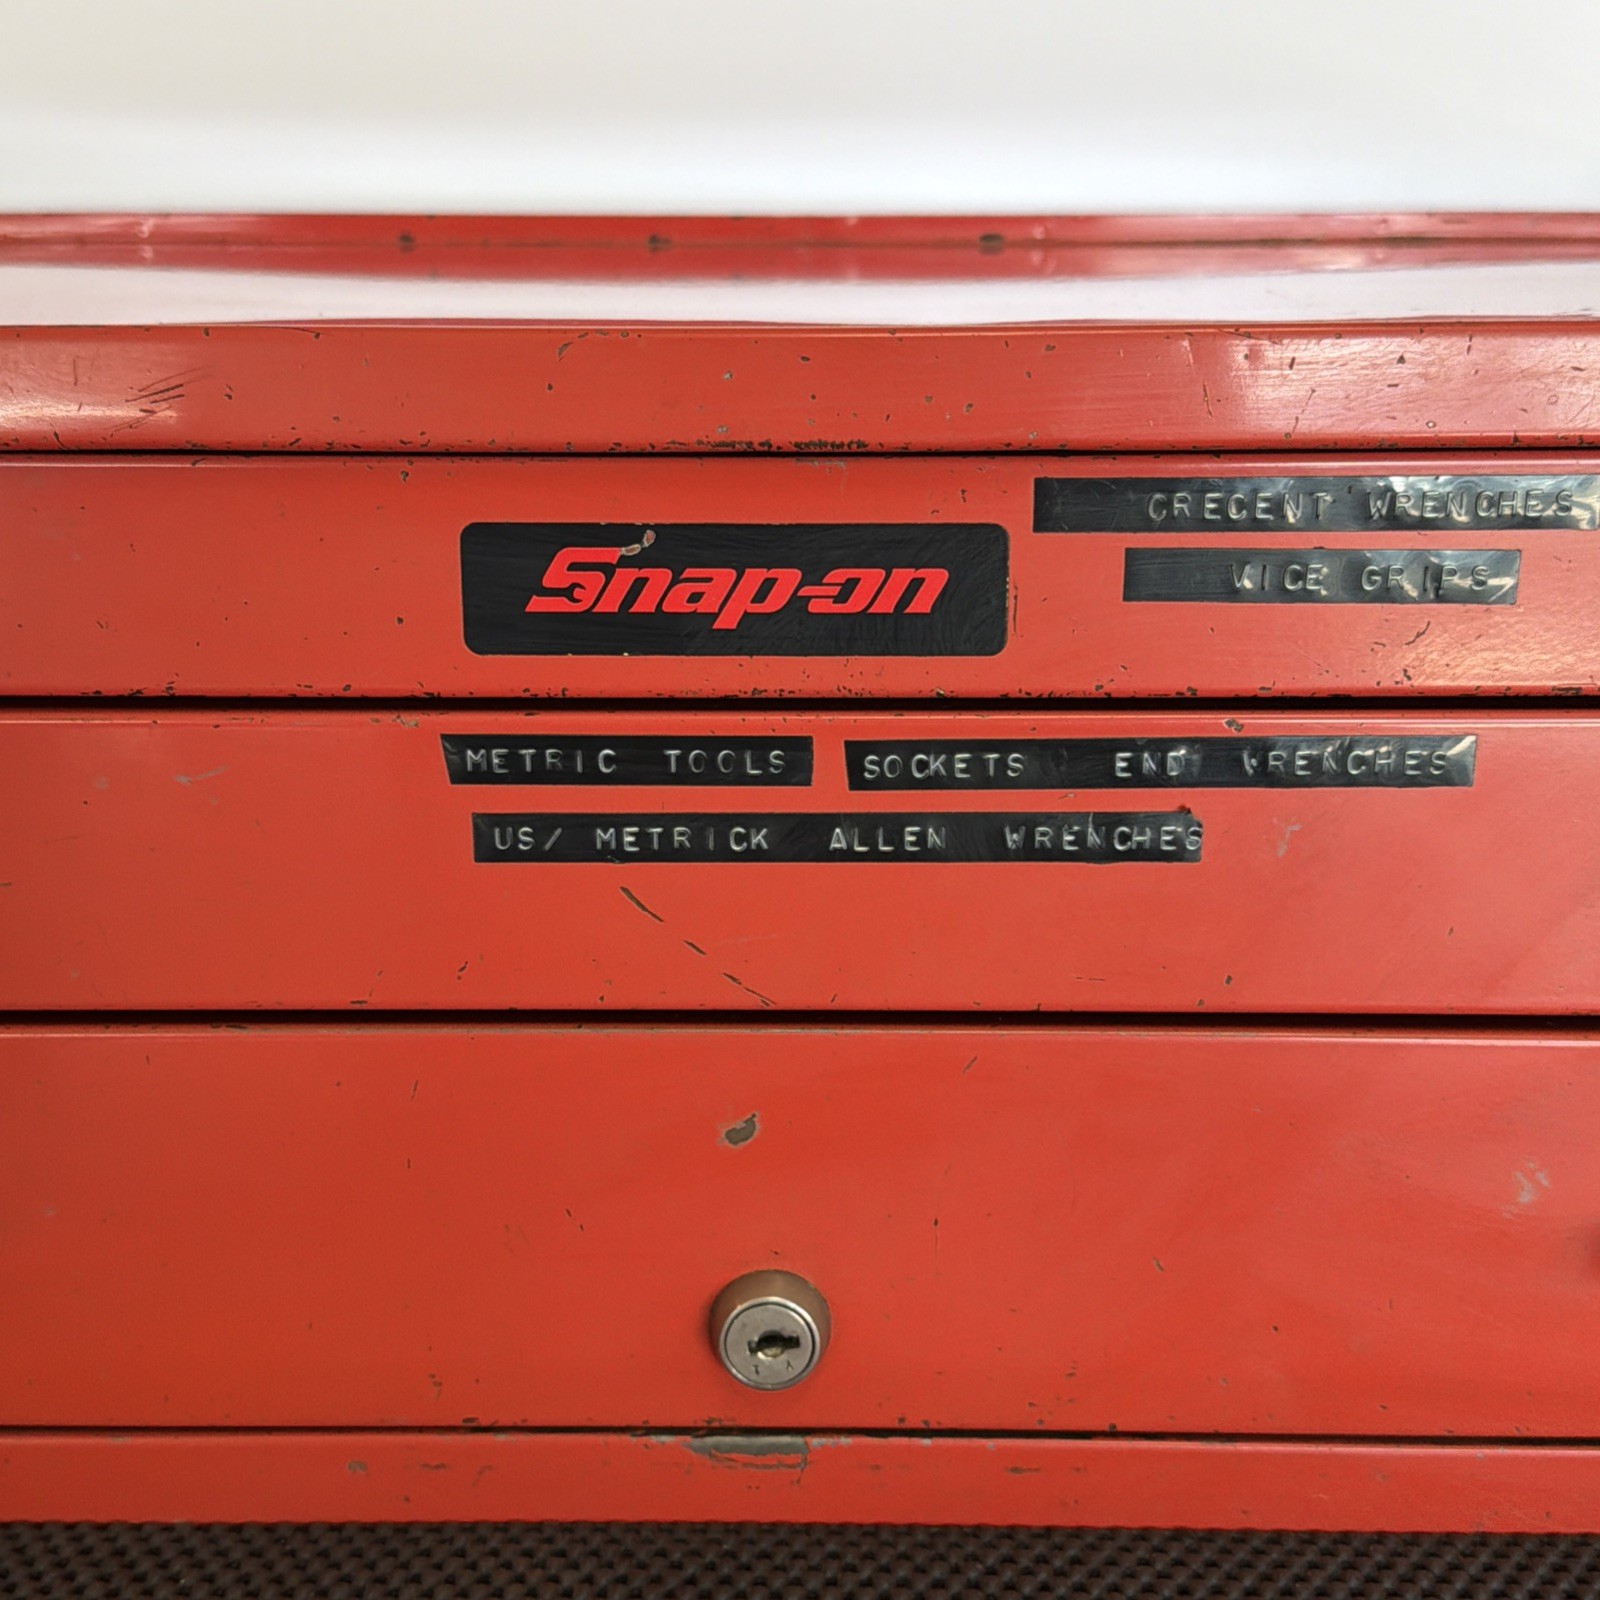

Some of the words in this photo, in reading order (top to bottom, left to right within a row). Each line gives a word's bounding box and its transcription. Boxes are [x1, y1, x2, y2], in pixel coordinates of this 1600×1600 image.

[1366, 488, 1574, 522] WRENCHES
[525, 546, 949, 630] Snap-on
[1229, 564, 1325, 593] VICE
[1361, 563, 1491, 595] GRIPS
[466, 748, 618, 774] METRIC
[664, 749, 786, 775] TOOLS
[863, 753, 1026, 780] SOCKETS
[1114, 751, 1189, 778] END
[1242, 749, 1450, 777] WRENCHES
[493, 826, 562, 852] US/
[595, 826, 769, 852] METRICK
[828, 825, 947, 852] ALLEN
[1003, 824, 1203, 852] WRENCHES
